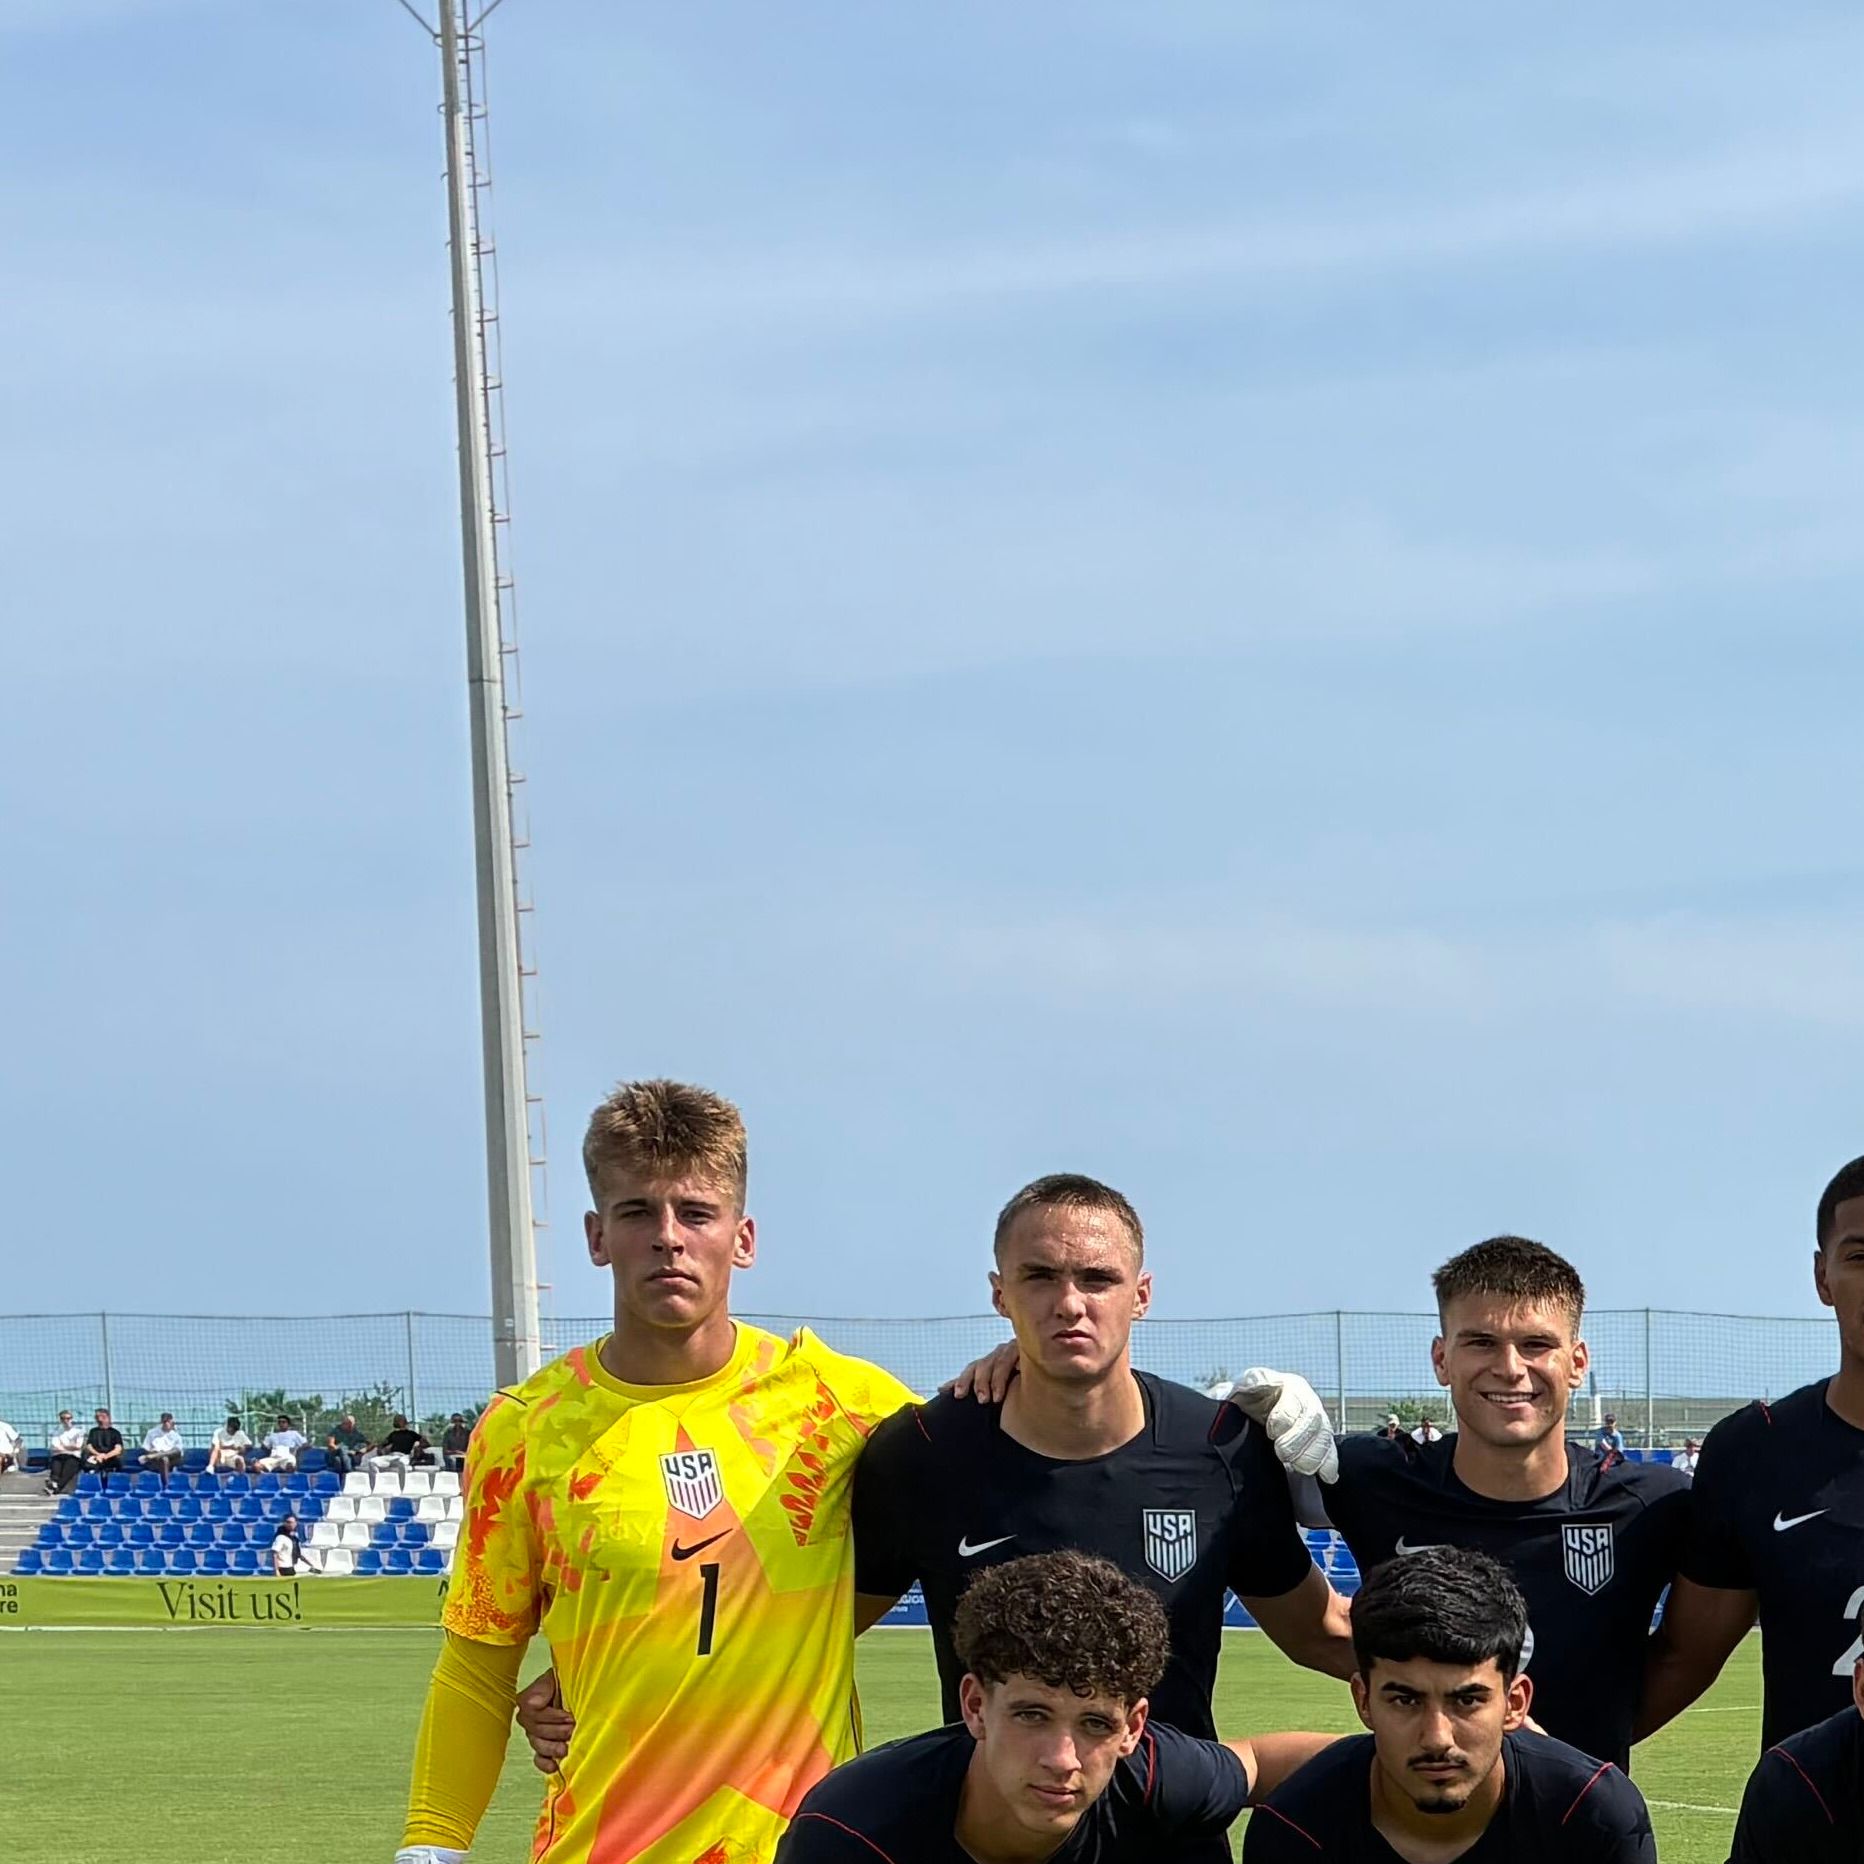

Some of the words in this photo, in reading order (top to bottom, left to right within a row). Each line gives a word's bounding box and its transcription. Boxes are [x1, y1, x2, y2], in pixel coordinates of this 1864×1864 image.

[665, 1453, 713, 1480] USA
[1149, 1513, 1191, 1541] USA
[1567, 1528, 1609, 1555] USA
[156, 1581, 240, 1620] Visit
[250, 1581, 302, 1620] us!
[696, 1562, 720, 1657] 1
